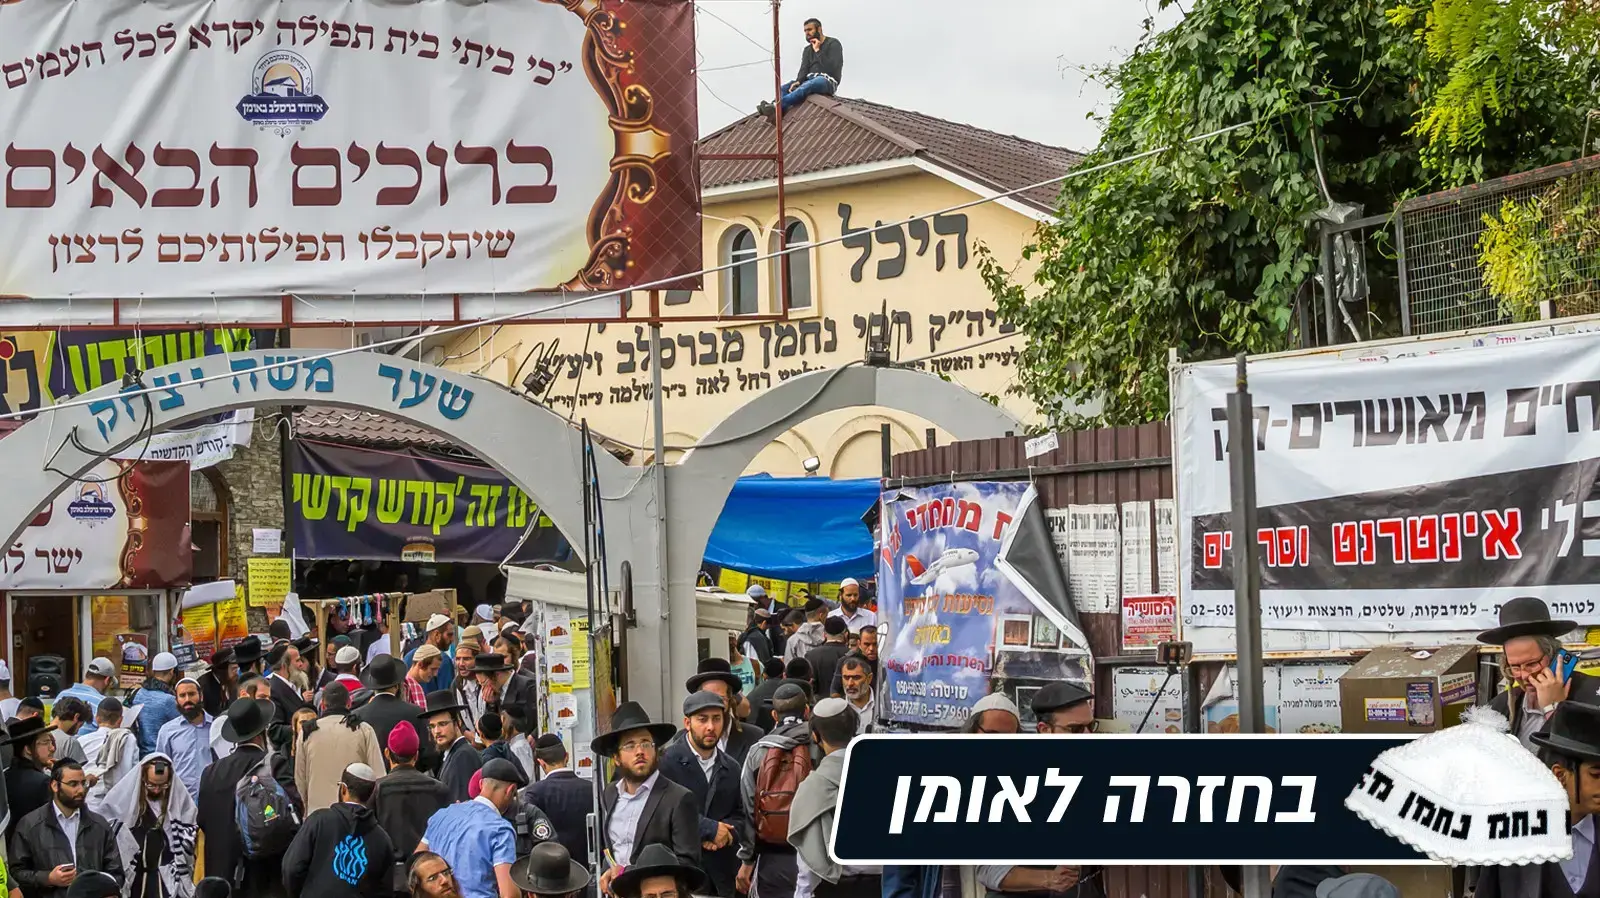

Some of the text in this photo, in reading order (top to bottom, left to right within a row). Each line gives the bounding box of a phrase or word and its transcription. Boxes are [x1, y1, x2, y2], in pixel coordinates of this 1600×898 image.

[114, 21, 178, 63] לכל
[188, 19, 265, 56] יקרא
[277, 15, 374, 50] תפילה
[384, 28, 439, 60] בית
[451, 39, 514, 77] ביתי
[242, 101, 323, 115] איחוד ברסלב באומן
[4, 139, 558, 209] ברוכים הבאים
[48, 226, 516, 274] שיתקבלו תפילותיכם לרצון
[838, 203, 969, 283] היכל
[617, 325, 745, 374] מברסלב
[759, 317, 837, 369] נחמן
[231, 353, 335, 395] משה
[696, 368, 730, 395] לאה
[737, 368, 771, 391] רחל
[931, 355, 973, 373] האשה
[87, 367, 204, 444] יצחק
[379, 363, 474, 419] שער
[610, 378, 654, 404] שלמה
[1503, 380, 1600, 438] חיים
[465, 484, 502, 527] זה
[905, 497, 982, 533] מחמדי
[1203, 524, 1310, 569] וסרים
[1332, 507, 1522, 565] אינטרנט
[35, 547, 83, 574] ישר
[1128, 601, 1173, 616] הסושיה
[1268, 605, 1303, 619] ויעוץ:
[1307, 605, 1353, 617] הרצאות
[1358, 603, 1404, 618] שלטים,
[1410, 602, 1476, 619] למדבקות,
[1551, 600, 1595, 614] לטוהר
